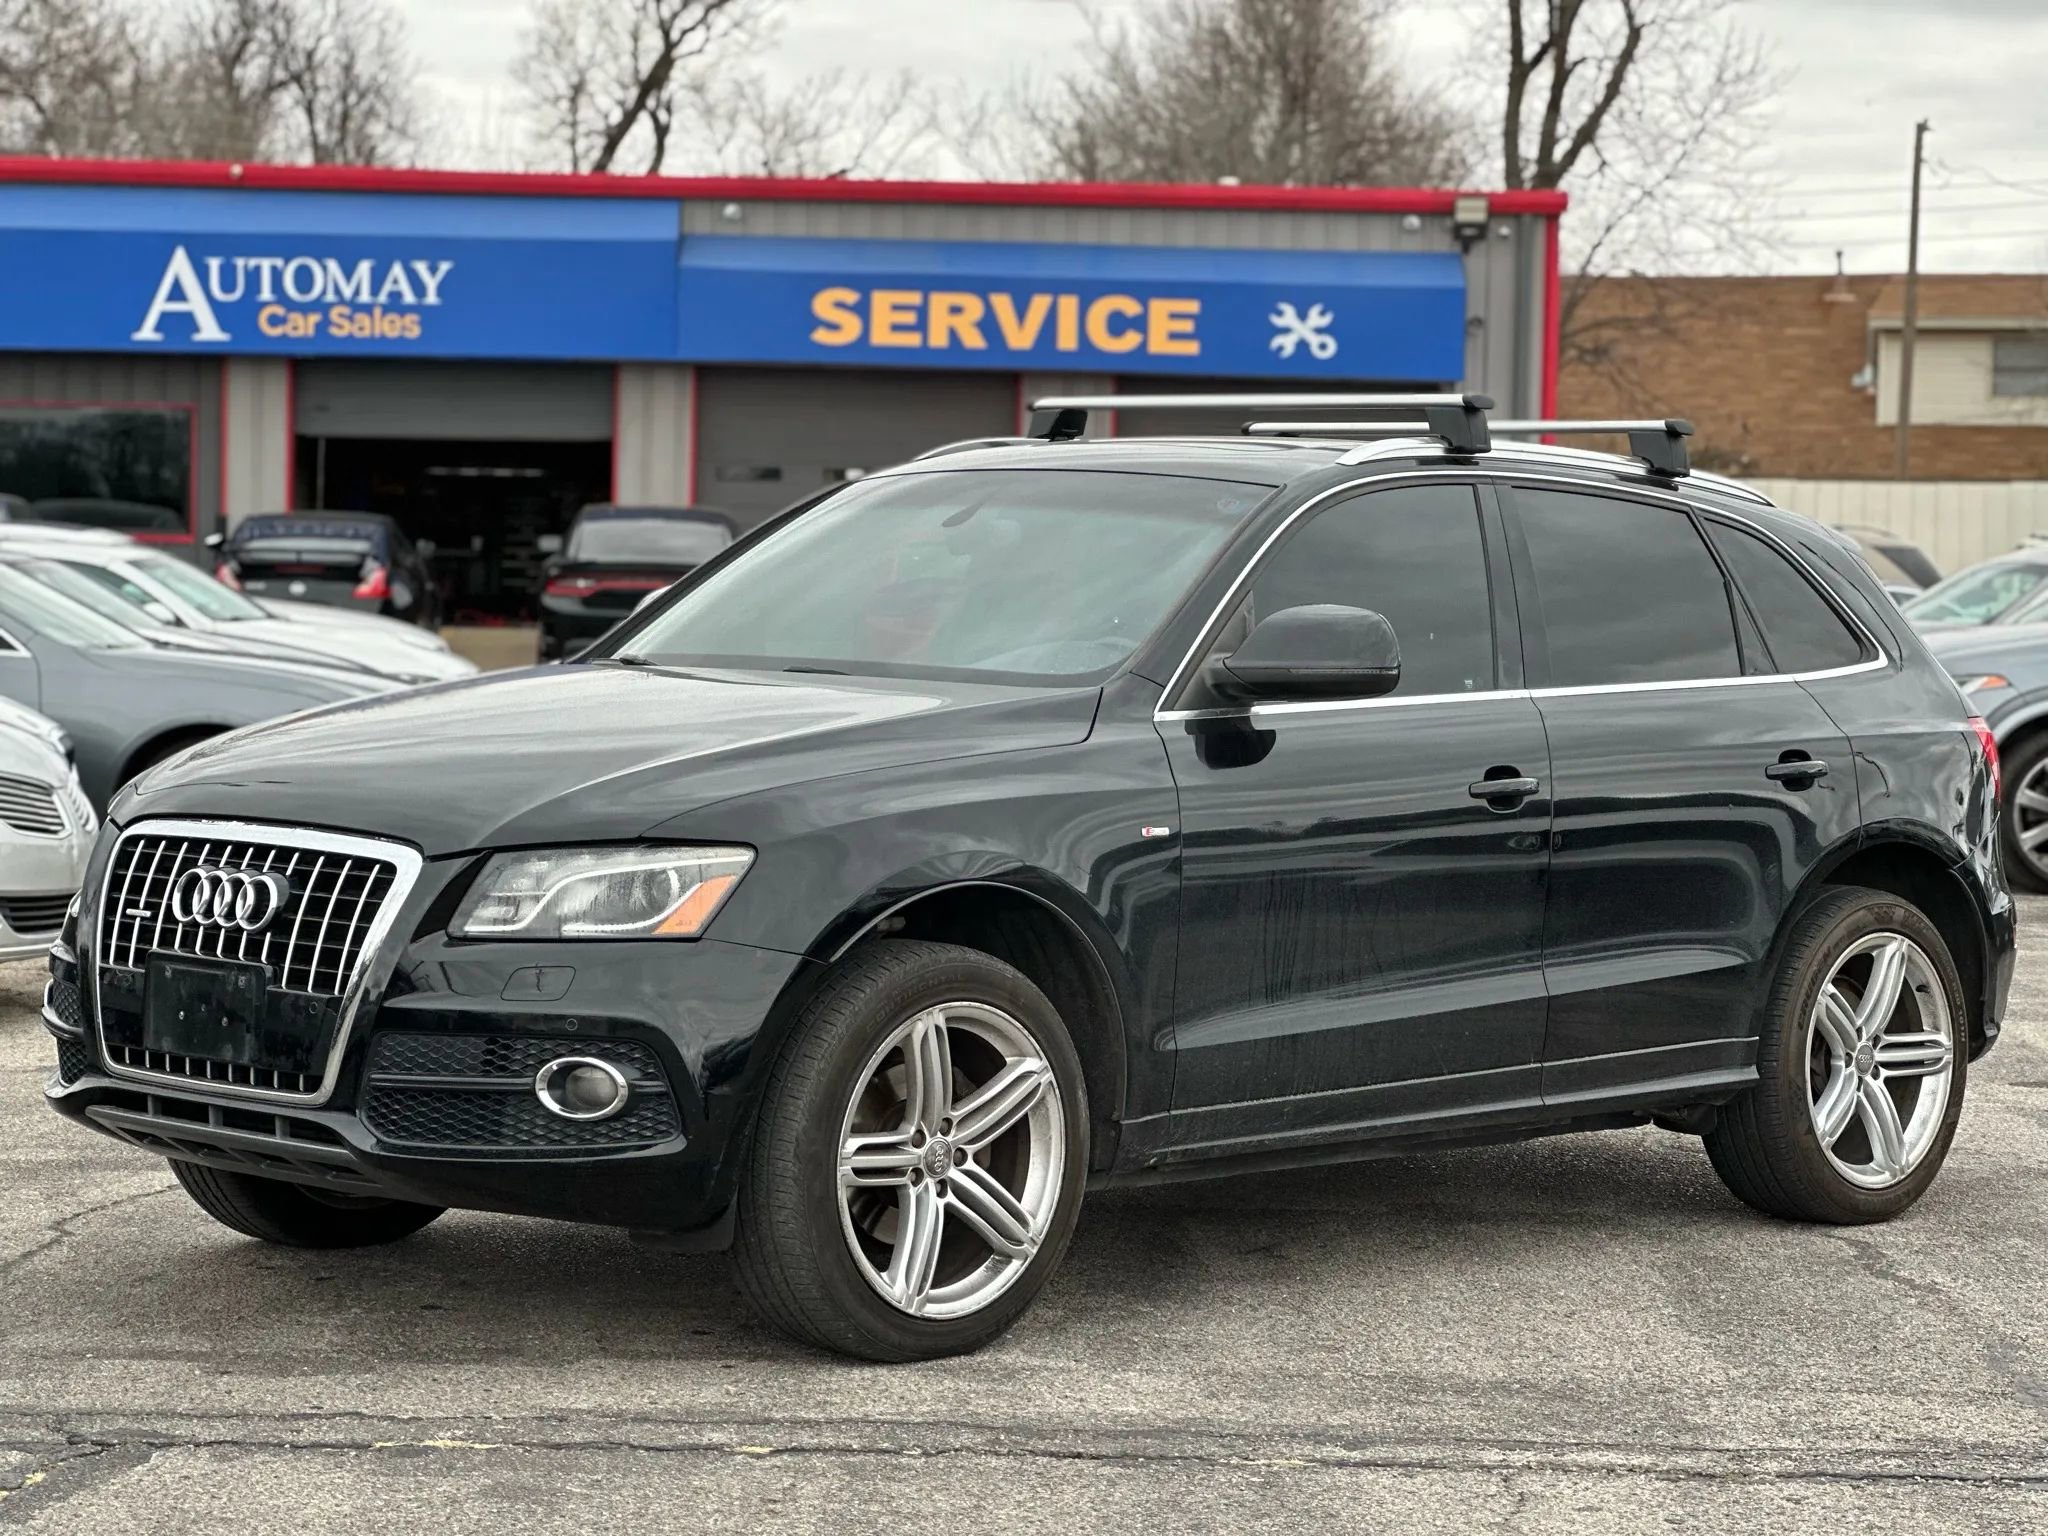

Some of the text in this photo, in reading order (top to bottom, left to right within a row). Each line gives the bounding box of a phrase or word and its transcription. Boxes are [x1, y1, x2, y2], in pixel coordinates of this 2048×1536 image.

[130, 245, 454, 342] AUTOMAY
[257, 304, 422, 339] Car Sales
[809, 287, 1201, 356] SERVICE
